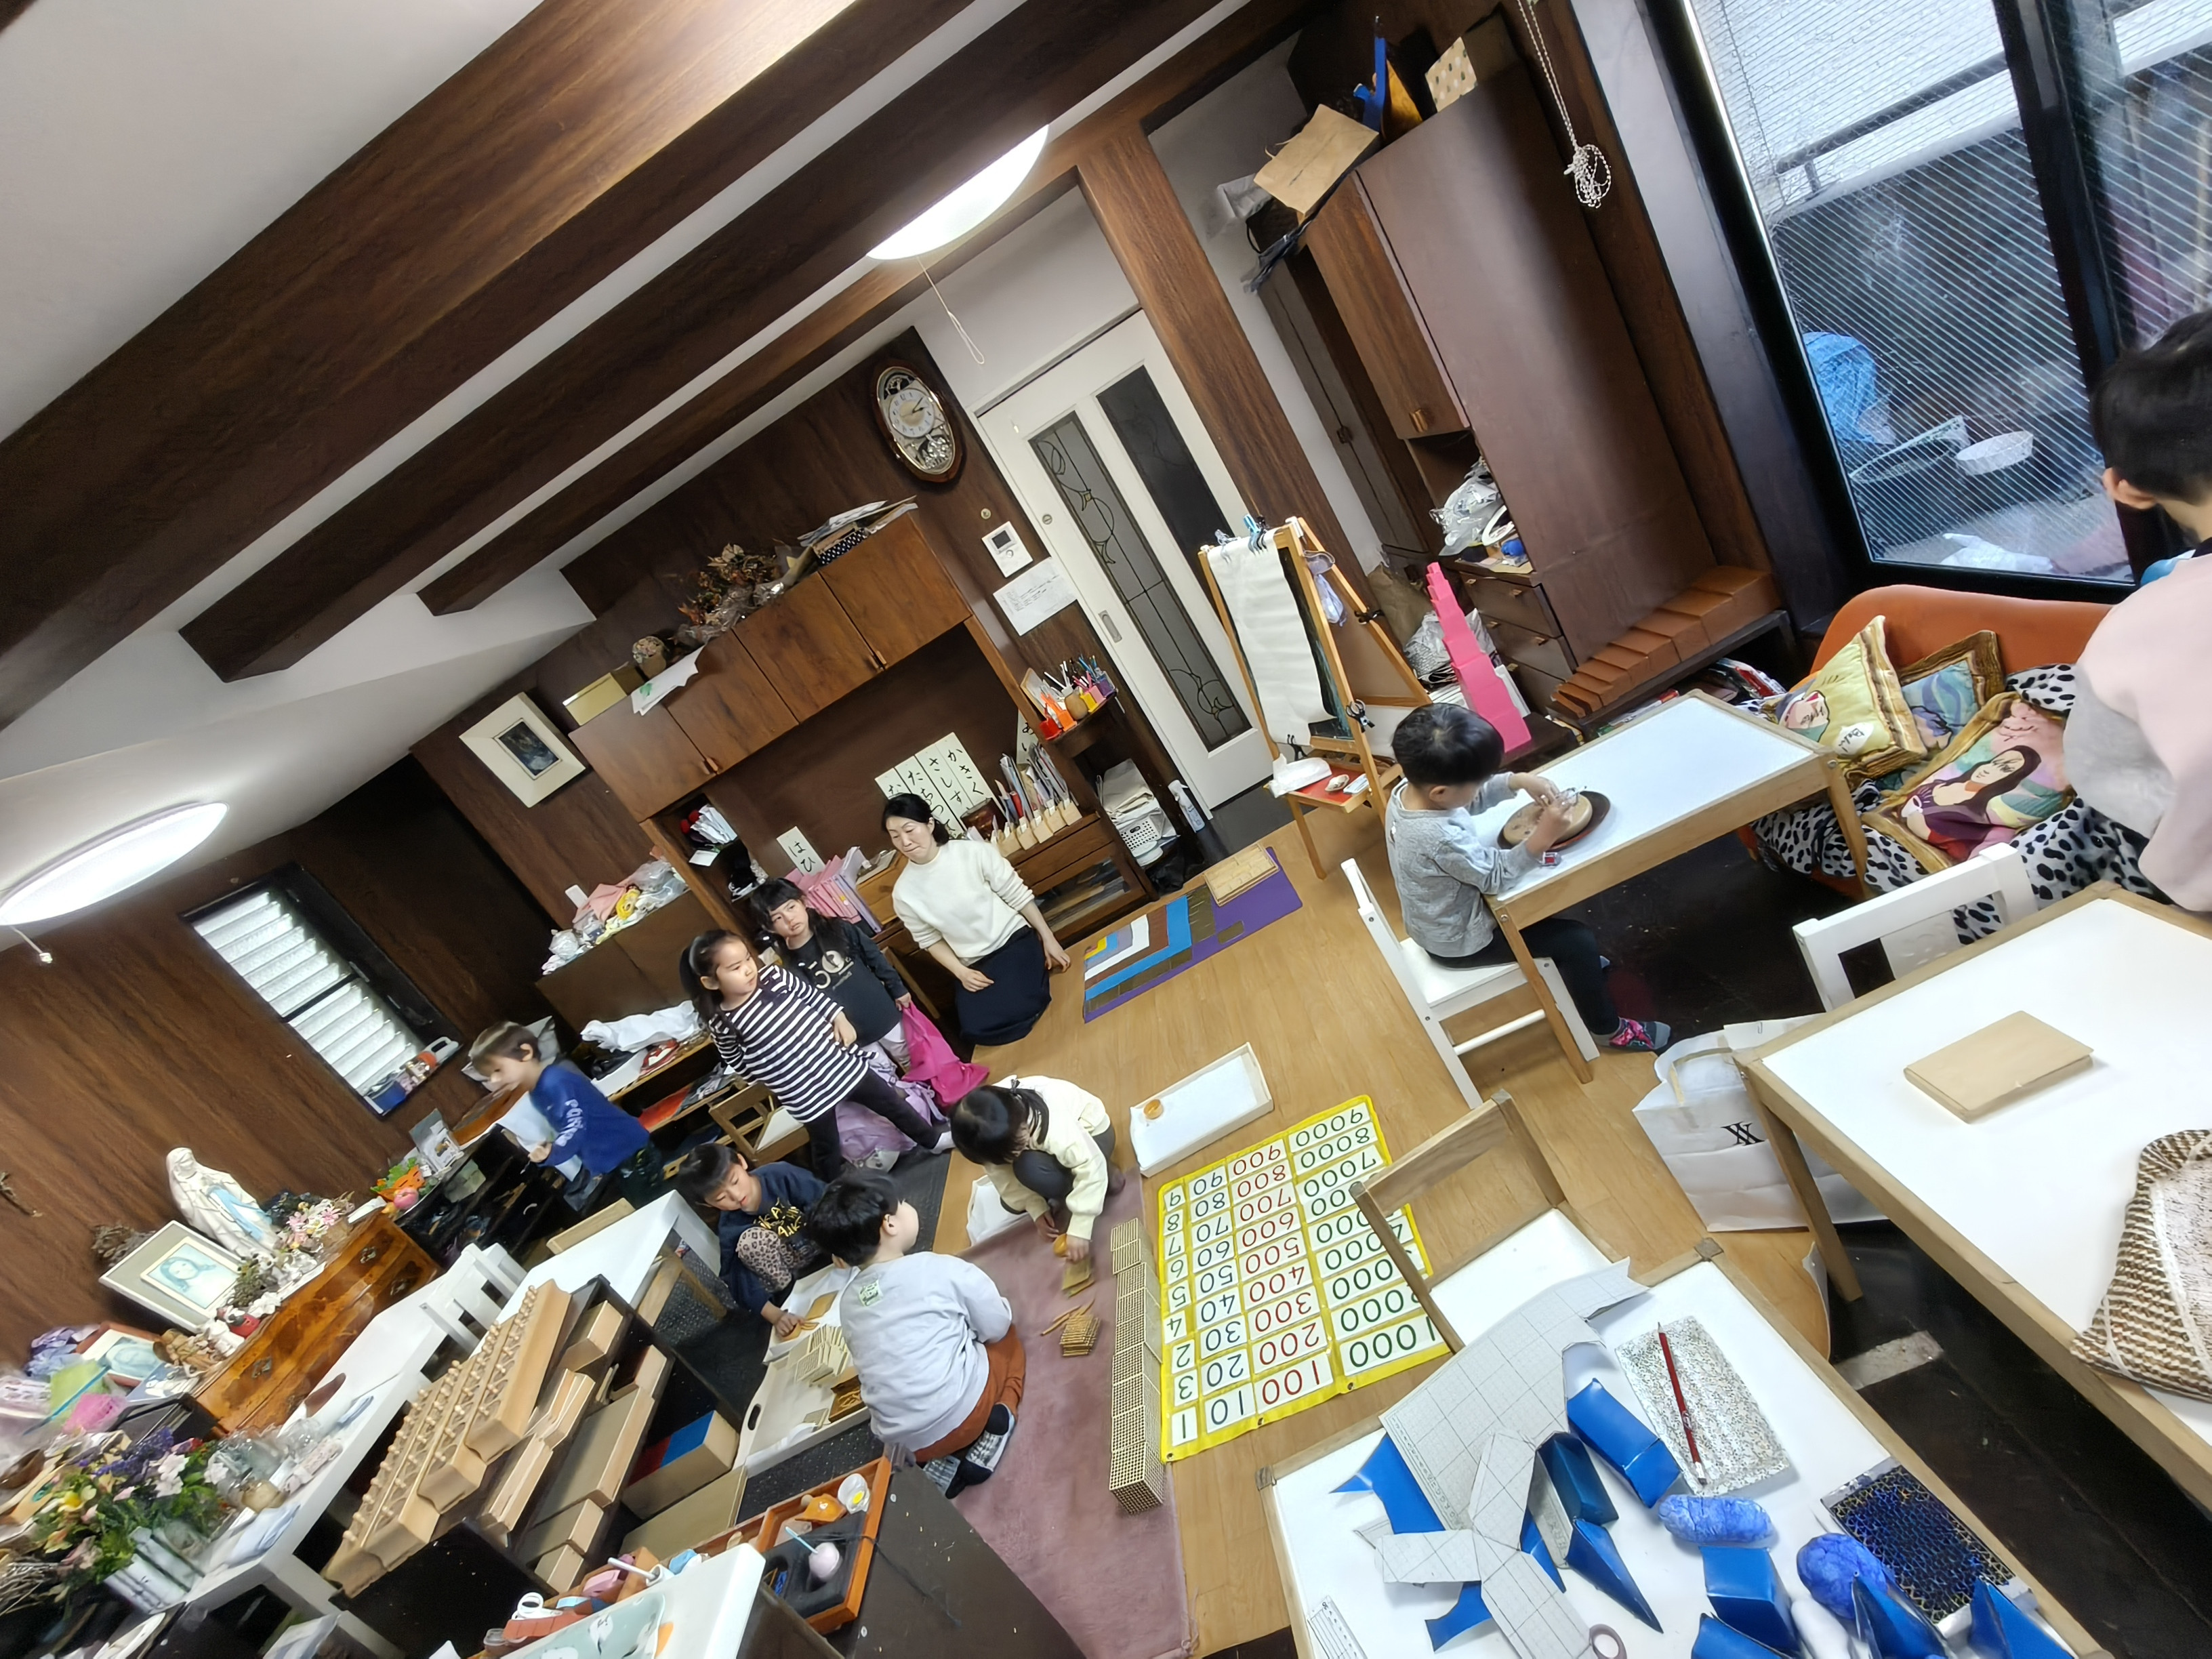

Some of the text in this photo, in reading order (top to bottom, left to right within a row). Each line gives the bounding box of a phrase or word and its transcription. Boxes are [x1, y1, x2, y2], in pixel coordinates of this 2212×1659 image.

[928, 758, 970, 810] さしす
[947, 748, 984, 795] かきく
[788, 841, 816, 873] はひ
[1170, 1109, 1363, 1207] 9000 900 90 9
[1167, 1128, 1370, 1231] 8000 800 80 8
[1168, 1151, 1376, 1256] 7000 700 70 7
[1242, 1212, 1294, 1247] 600
[1170, 1259, 1184, 1278] 6
[1172, 1210, 1394, 1307] 000 500 50 5
[1197, 1240, 1230, 1267] 60
[1249, 1266, 1305, 1303] 400
[1166, 1317, 1182, 1338] 4
[1176, 1250, 1412, 1368] 000 300 30 2
[1201, 1294, 1235, 1323] 40
[1259, 1322, 1319, 1365] 200
[1349, 1316, 1435, 1368] 1000
[1178, 1375, 1193, 1400] 3
[1207, 1353, 1244, 1387] 20
[1262, 1359, 1320, 1405] 100
[1210, 1390, 1244, 1425] 10
